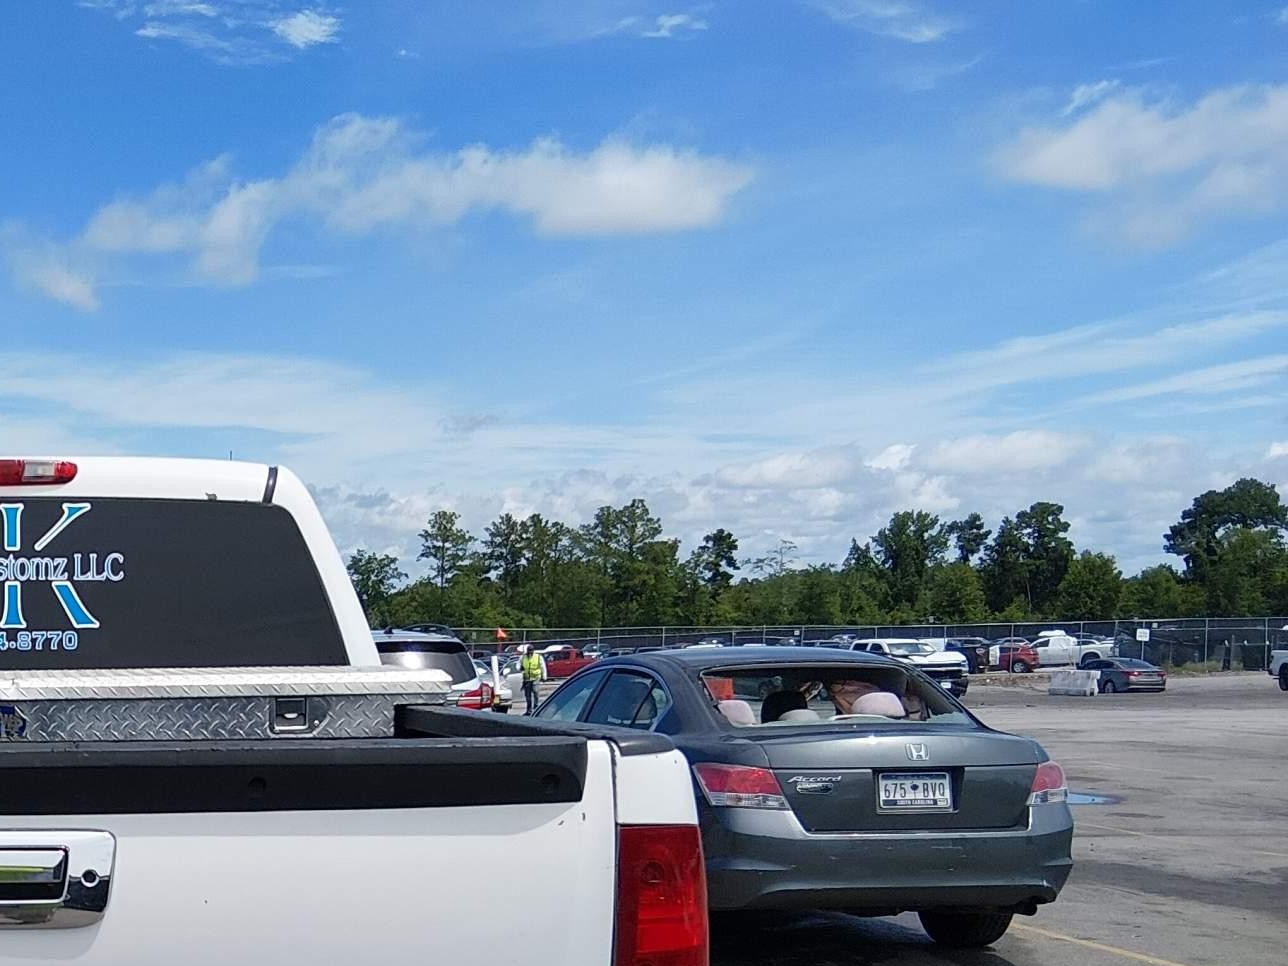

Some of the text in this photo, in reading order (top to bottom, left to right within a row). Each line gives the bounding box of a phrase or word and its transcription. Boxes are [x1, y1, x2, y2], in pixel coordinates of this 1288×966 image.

[73, 553, 124, 581] LLC
[884, 782, 945, 798] 675 BVQ
